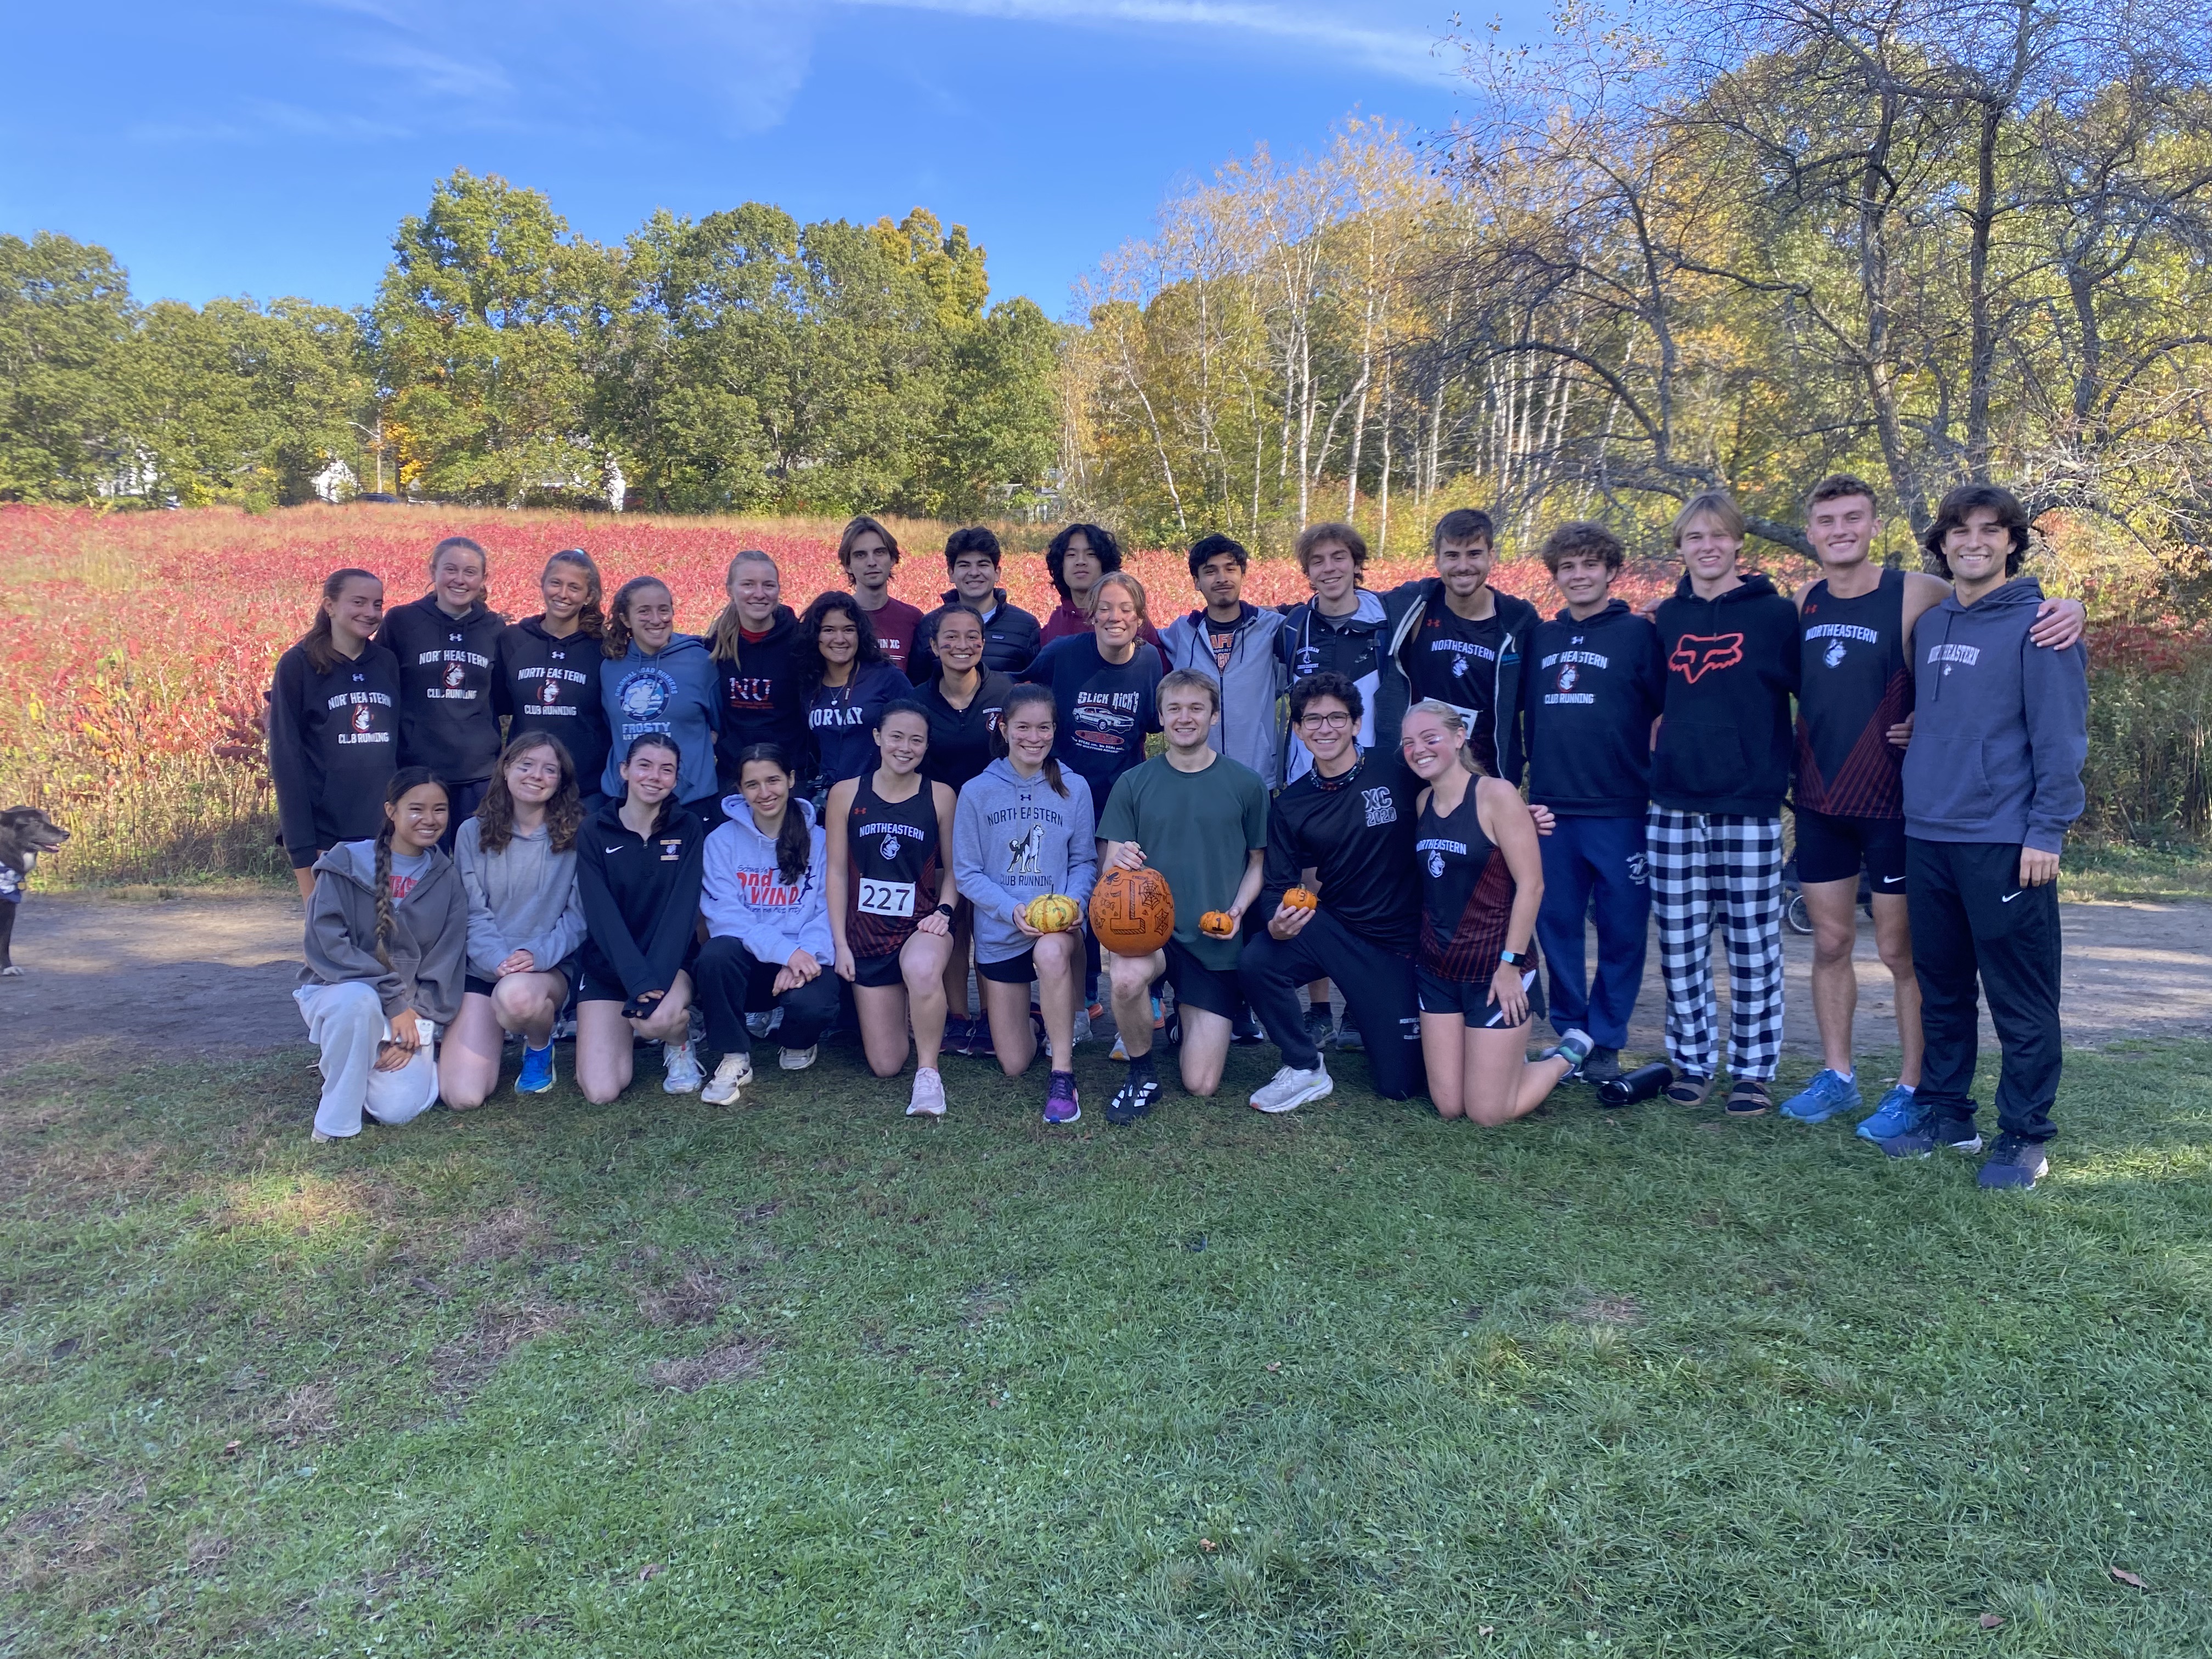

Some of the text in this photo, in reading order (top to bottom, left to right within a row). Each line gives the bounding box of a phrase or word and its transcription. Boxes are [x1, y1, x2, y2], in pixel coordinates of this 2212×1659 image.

[889, 639, 900, 649] XC
[729, 677, 772, 701] NU
[1545, 693, 1594, 704] CLUB RUNNING
[524, 704, 577, 716] CLUB RUNNING
[622, 721, 671, 733] FROSTY
[1362, 786, 1392, 812] XC
[1365, 806, 1397, 827] 2020
[859, 823, 924, 841] NORTHEASTERN
[1000, 874, 1052, 887] CLUB RUNNING
[751, 885, 799, 905] WIND
[862, 884, 910, 911] 227
[1110, 878, 1146, 935] 1
[1212, 917, 1224, 932] 1
